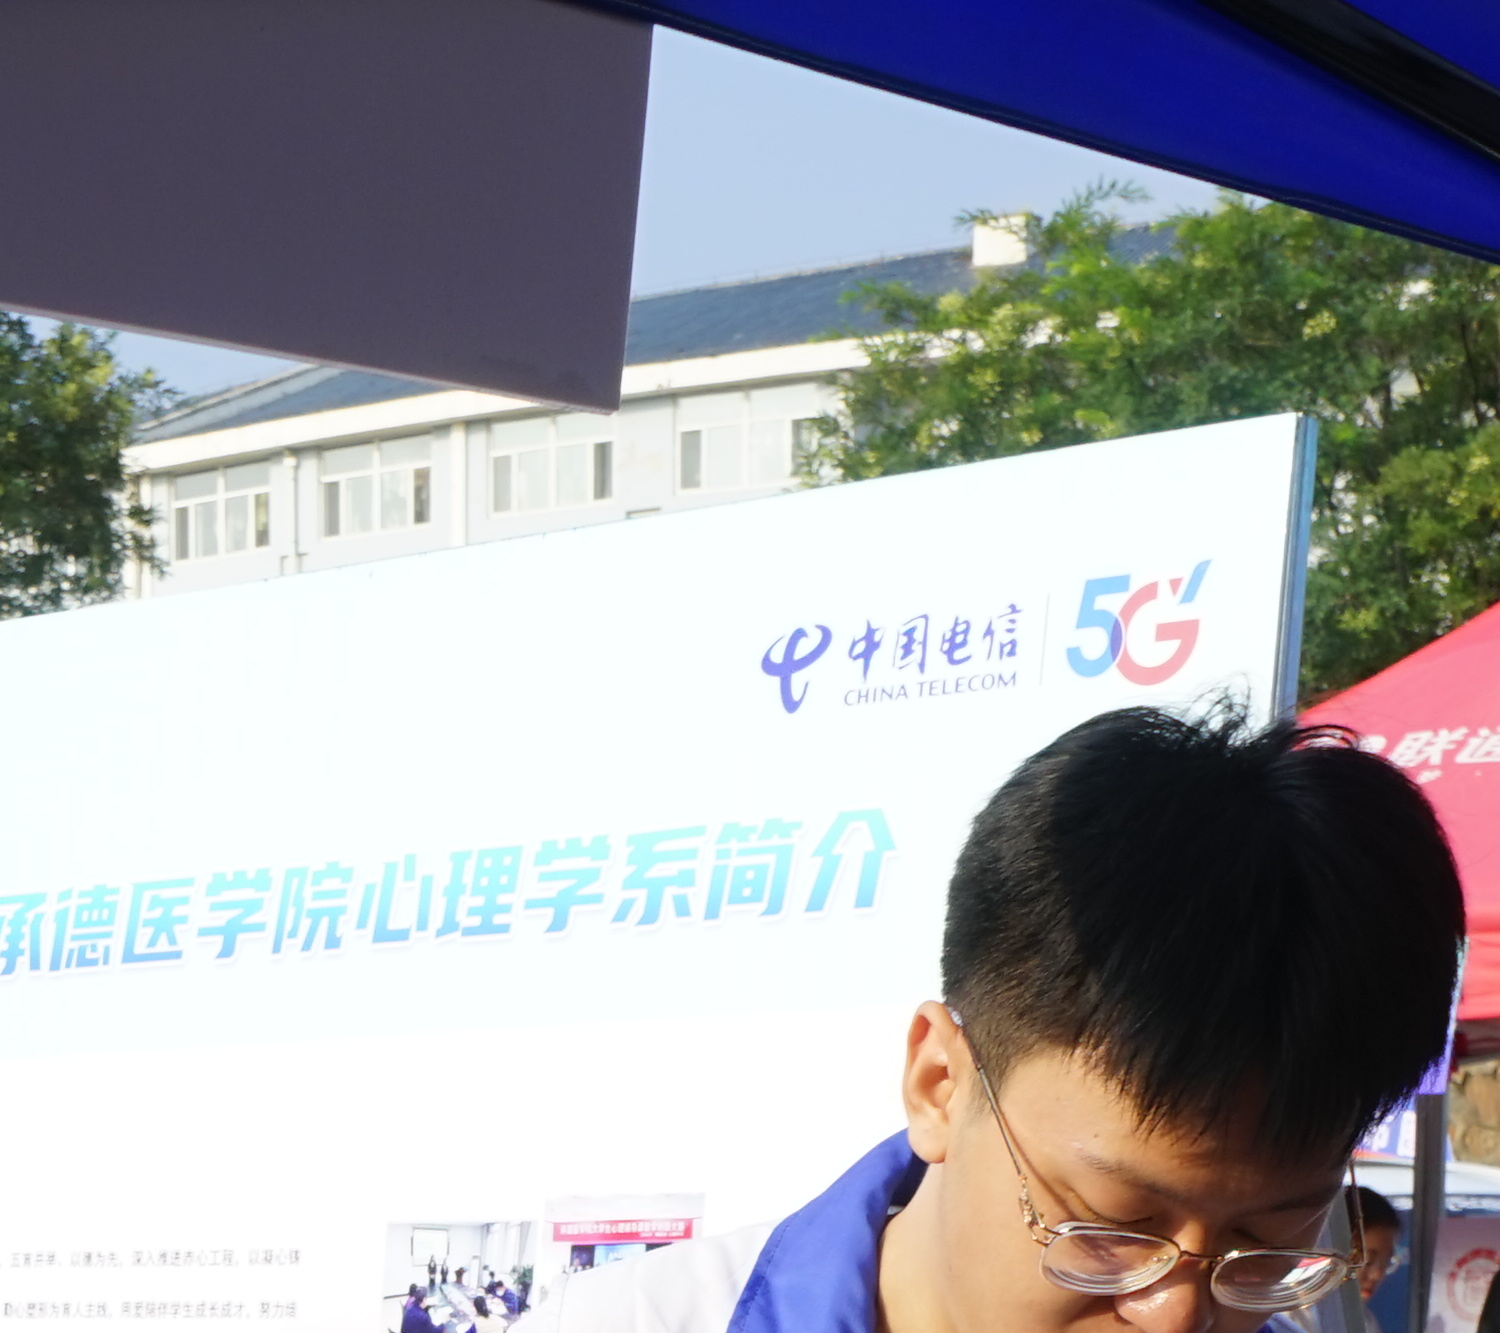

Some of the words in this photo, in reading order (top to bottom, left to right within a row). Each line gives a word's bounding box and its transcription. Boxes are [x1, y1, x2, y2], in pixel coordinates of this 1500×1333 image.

[845, 603, 1022, 680] 中国电信
[1063, 557, 1212, 688] 5G
[842, 681, 910, 707] CHINA
[916, 671, 1019, 700] TELECOM
